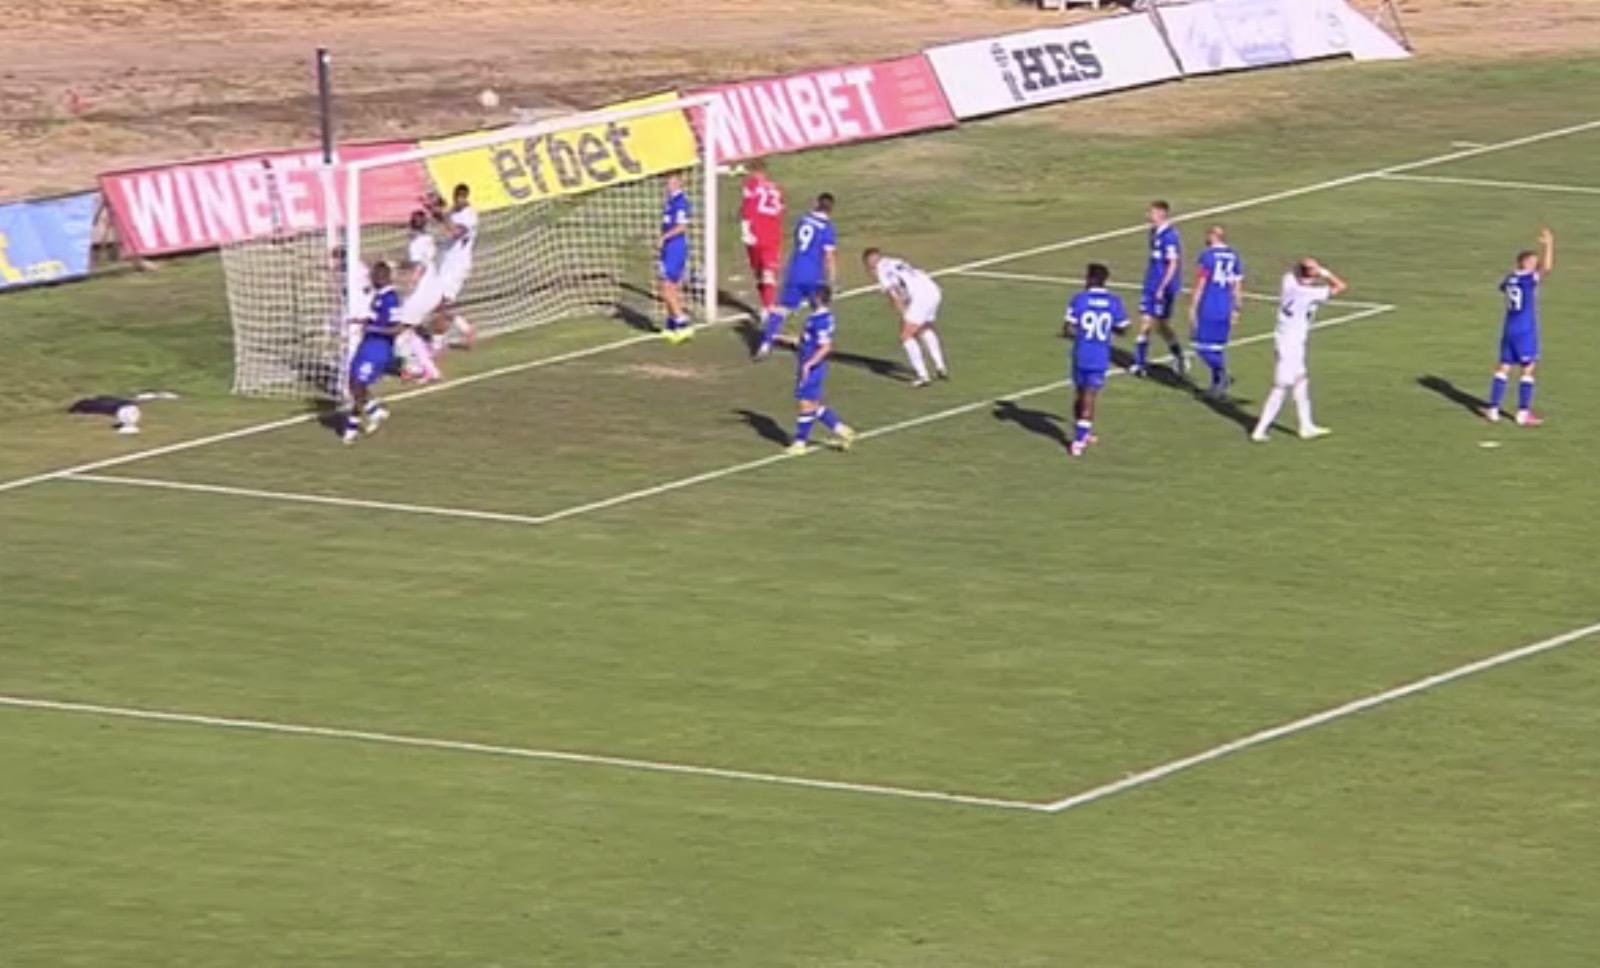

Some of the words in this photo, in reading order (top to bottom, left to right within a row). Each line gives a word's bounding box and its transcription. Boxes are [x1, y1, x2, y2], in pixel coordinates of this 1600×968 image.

[1010, 39, 1104, 92] HES
[709, 69, 886, 159] WINBET
[492, 120, 642, 200] efbet
[755, 185, 783, 215] 23
[798, 224, 816, 252] 9
[1079, 311, 1113, 341] 90
